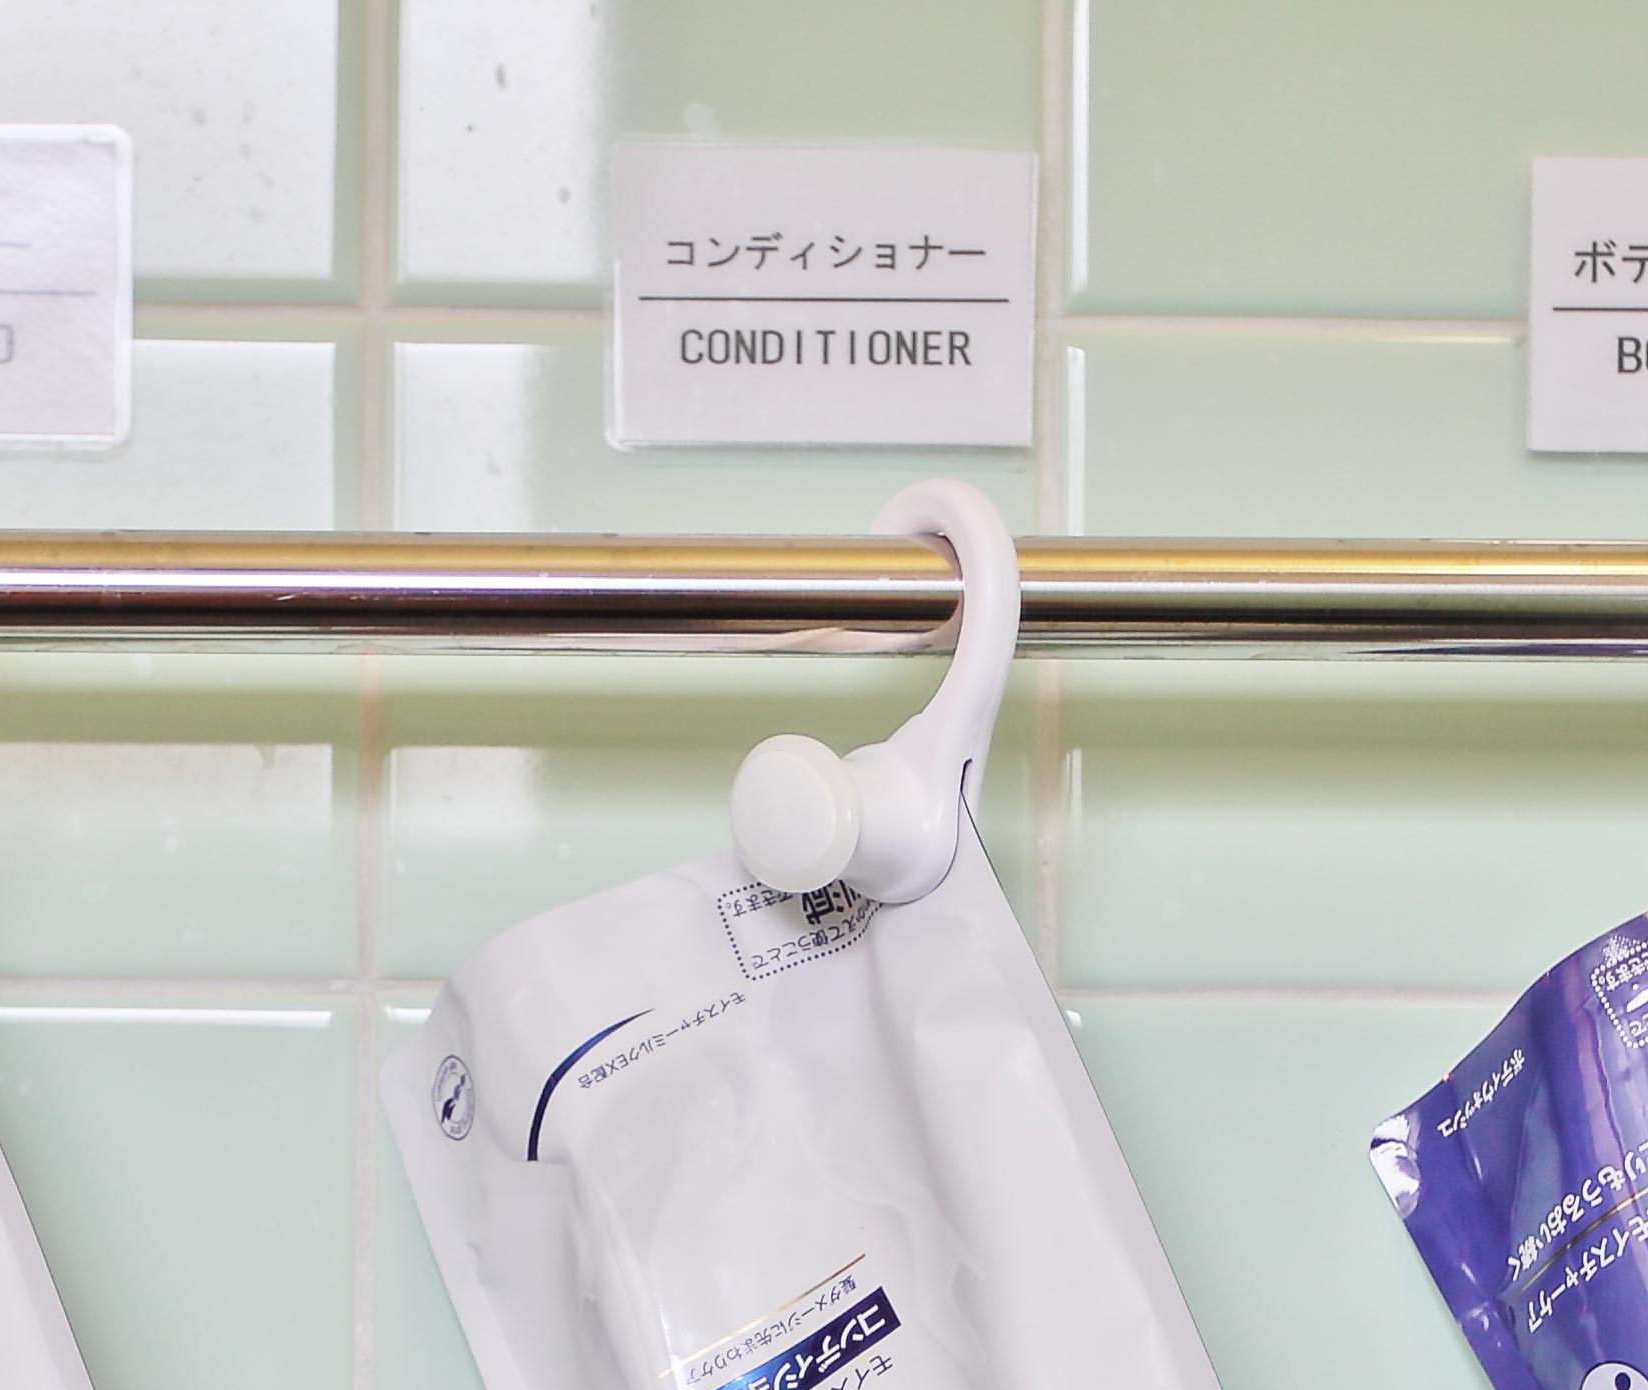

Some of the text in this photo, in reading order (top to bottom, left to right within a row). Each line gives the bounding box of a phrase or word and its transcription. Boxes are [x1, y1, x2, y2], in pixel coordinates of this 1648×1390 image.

[666, 231, 987, 272] コンディショナー
[679, 328, 973, 367] CONDITIONER
[577, 991, 747, 1090] モイスチャーミルクEX配合
